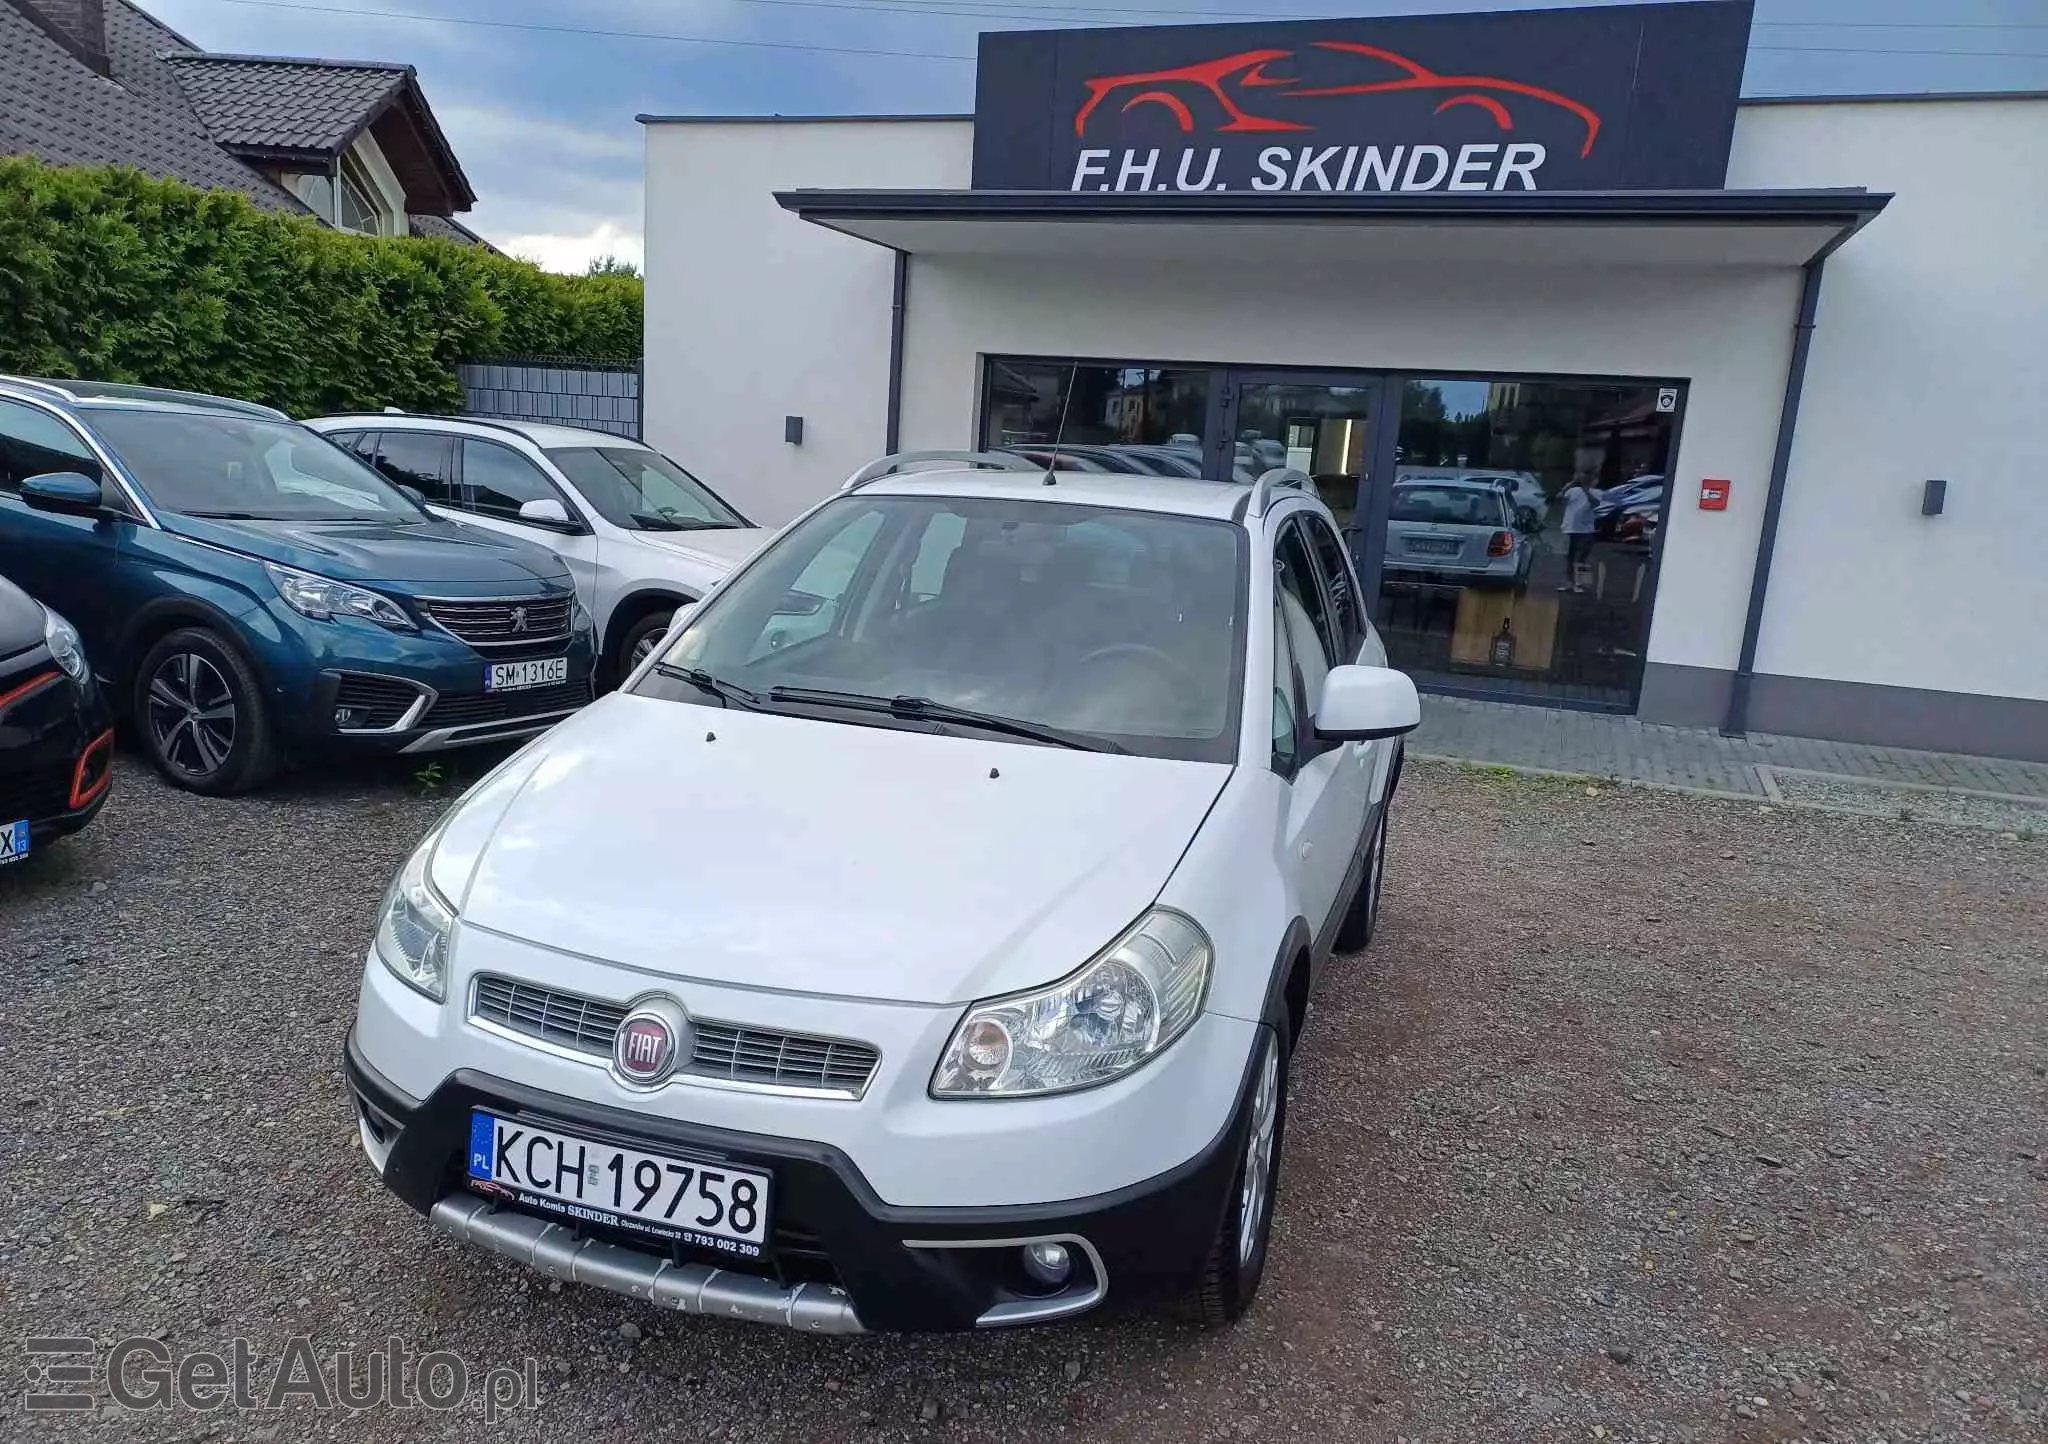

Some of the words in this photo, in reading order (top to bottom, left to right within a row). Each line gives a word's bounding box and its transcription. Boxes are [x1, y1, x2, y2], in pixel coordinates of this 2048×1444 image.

[1071, 148, 1227, 191] F.H.U.
[1250, 143, 1547, 191] SKINDER
[495, 664, 515, 686] SM
[522, 659, 564, 683] 1316E
[627, 1031, 662, 1064] FIAT
[473, 1152, 490, 1170] PL
[495, 1126, 585, 1199] KCH
[607, 1153, 758, 1234] 19758
[518, 1192, 539, 1207] Auto
[540, 1199, 566, 1214] Komis
[567, 1204, 619, 1227] SKINDER
[694, 1233, 715, 1247] 793
[716, 1238, 737, 1252] 002
[739, 1243, 760, 1257] 309
